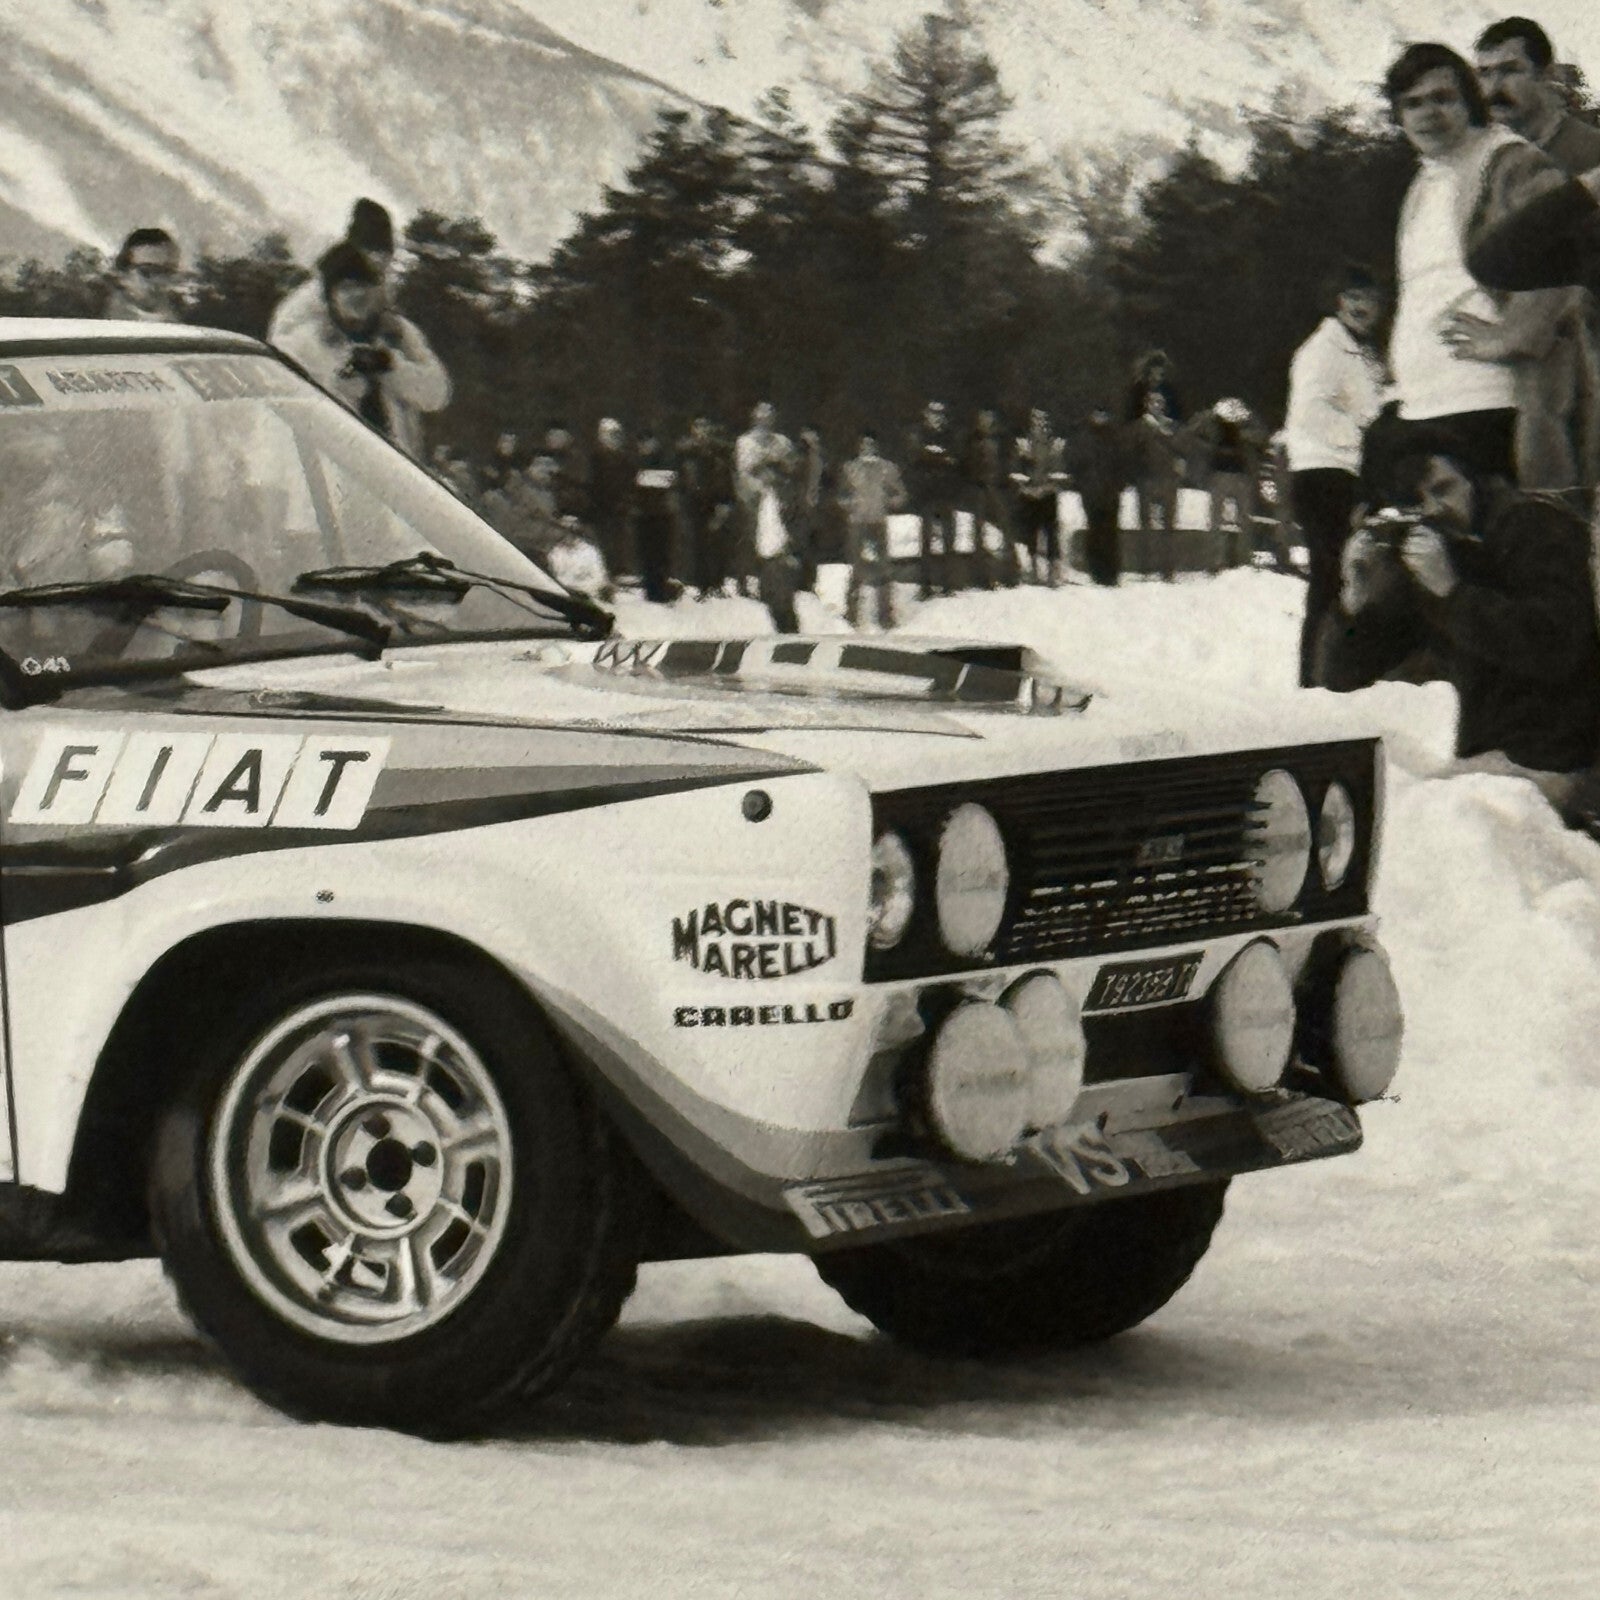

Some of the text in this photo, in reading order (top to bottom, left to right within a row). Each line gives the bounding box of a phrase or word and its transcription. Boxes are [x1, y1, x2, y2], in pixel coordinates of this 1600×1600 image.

[39, 745, 371, 816] FIAT
[672, 898, 837, 955] MAGNETI
[672, 920, 837, 980] MARELLI
